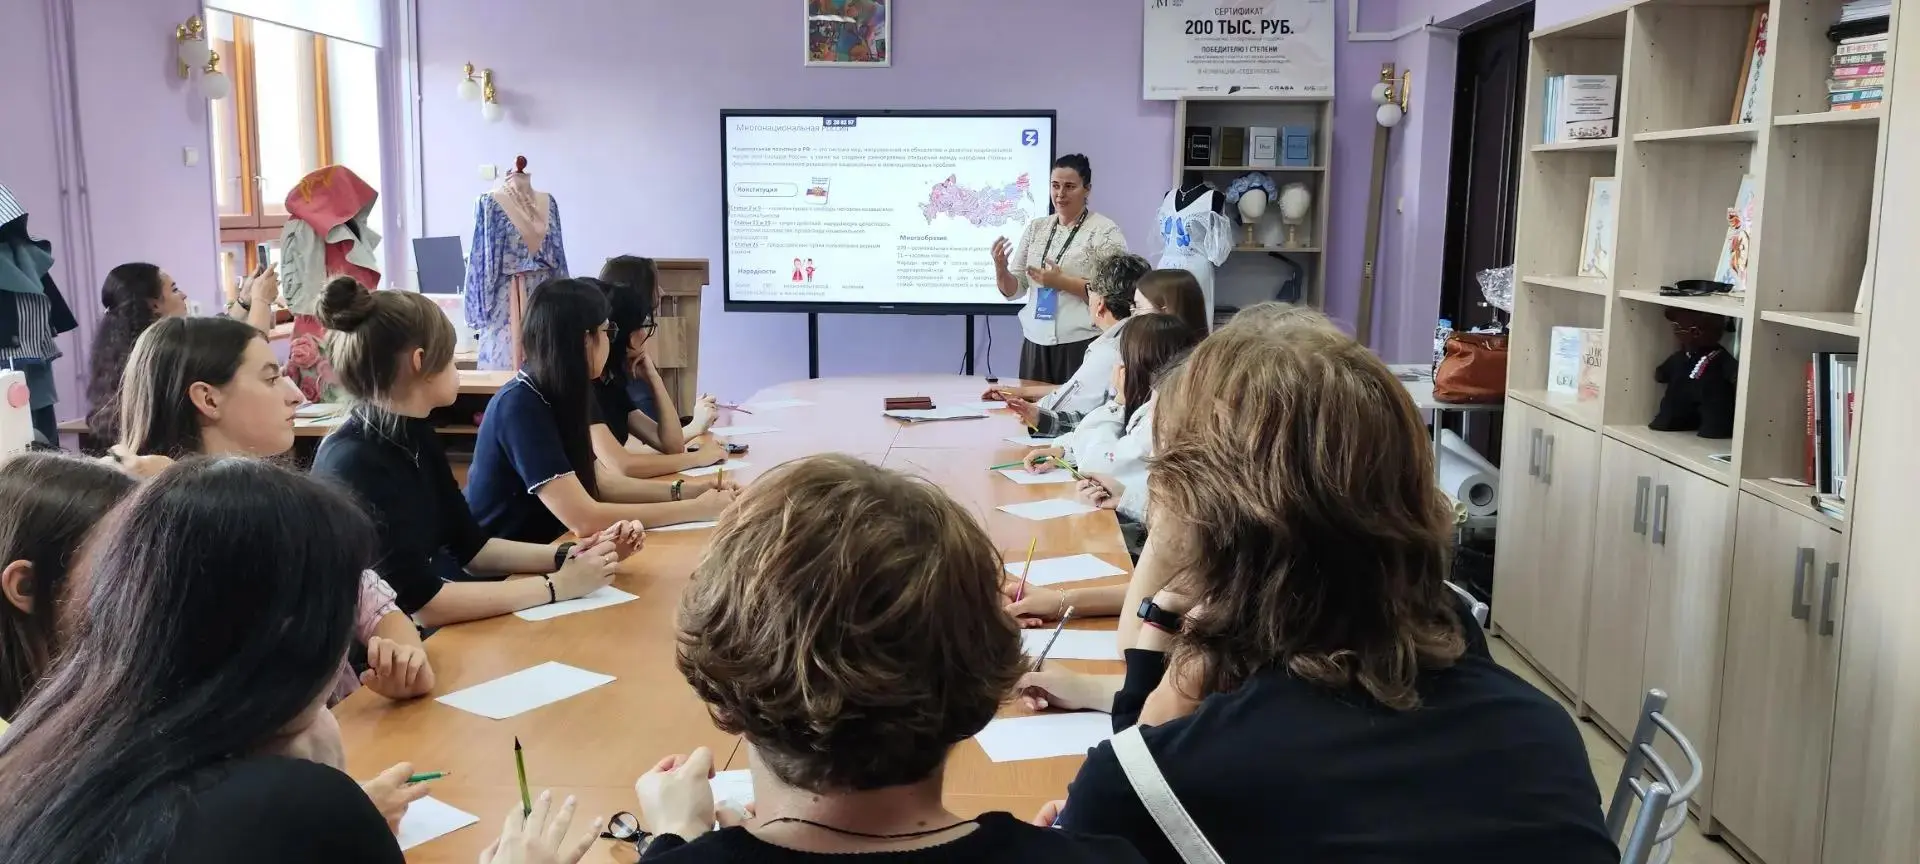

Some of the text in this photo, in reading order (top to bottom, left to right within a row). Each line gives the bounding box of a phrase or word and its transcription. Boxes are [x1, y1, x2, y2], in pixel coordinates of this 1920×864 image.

[1214, 7, 1264, 16] СЕРТИФИКАТ
[1185, 19, 1294, 35] 200 ТЫС. РУБ.
[1201, 46, 1244, 54] ПОБЕДИТЕЛЮ
[736, 123, 820, 133] Многонациональная
[737, 186, 778, 195] Конституция
